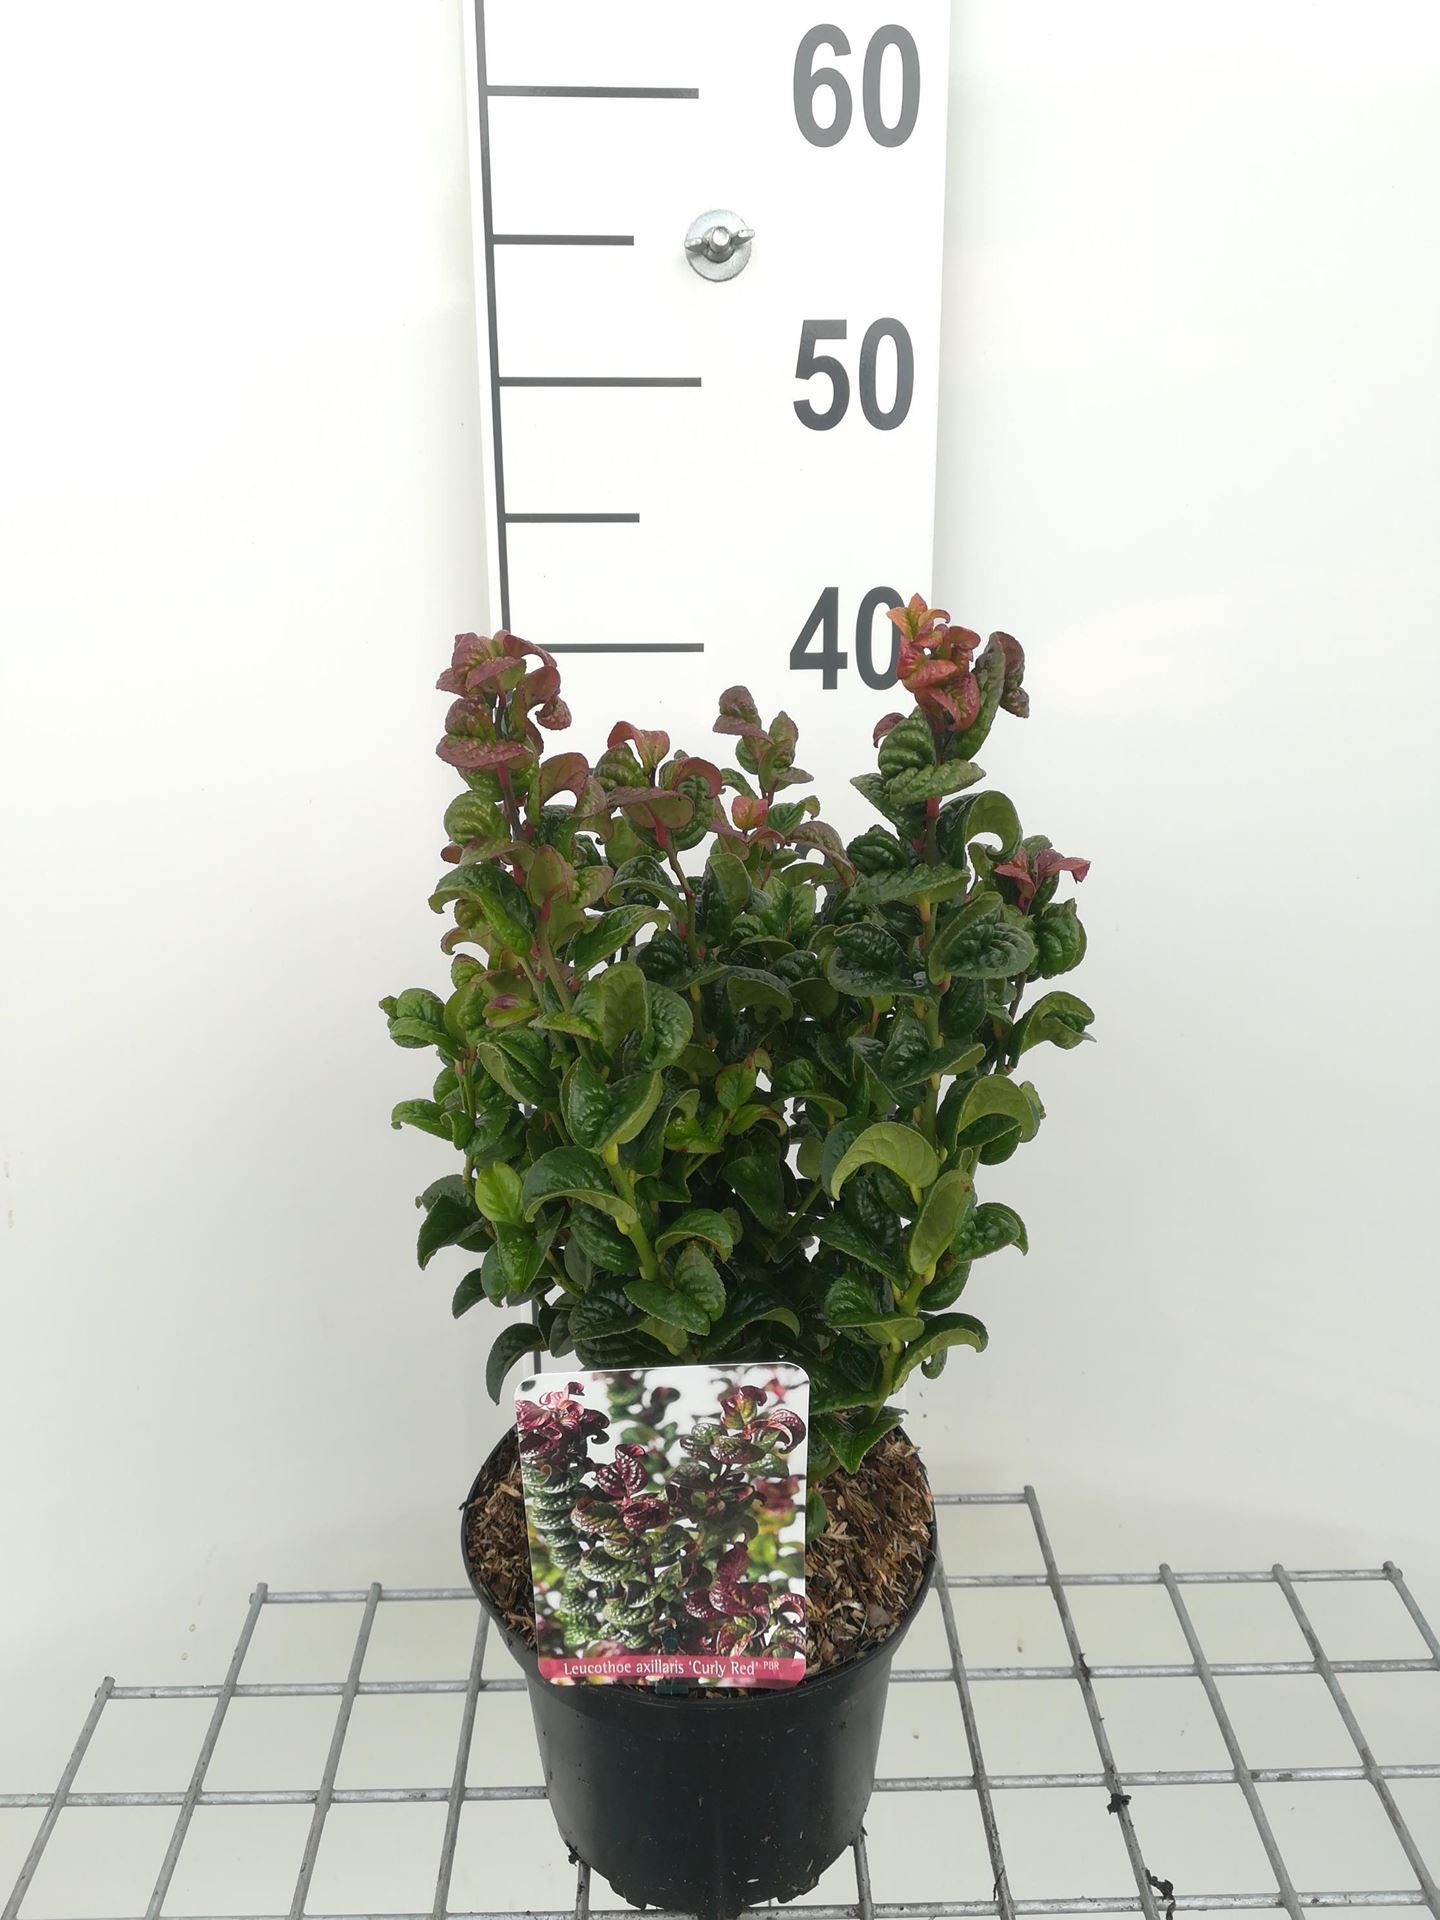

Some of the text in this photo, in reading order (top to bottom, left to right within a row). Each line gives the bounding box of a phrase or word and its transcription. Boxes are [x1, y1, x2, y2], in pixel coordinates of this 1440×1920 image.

[793, 23, 921, 149] 60
[793, 317, 914, 431] 50
[789, 586, 905, 690] 40
[563, 1660, 780, 1677] Leucothoe axillaris 'Curly Red' PBR
